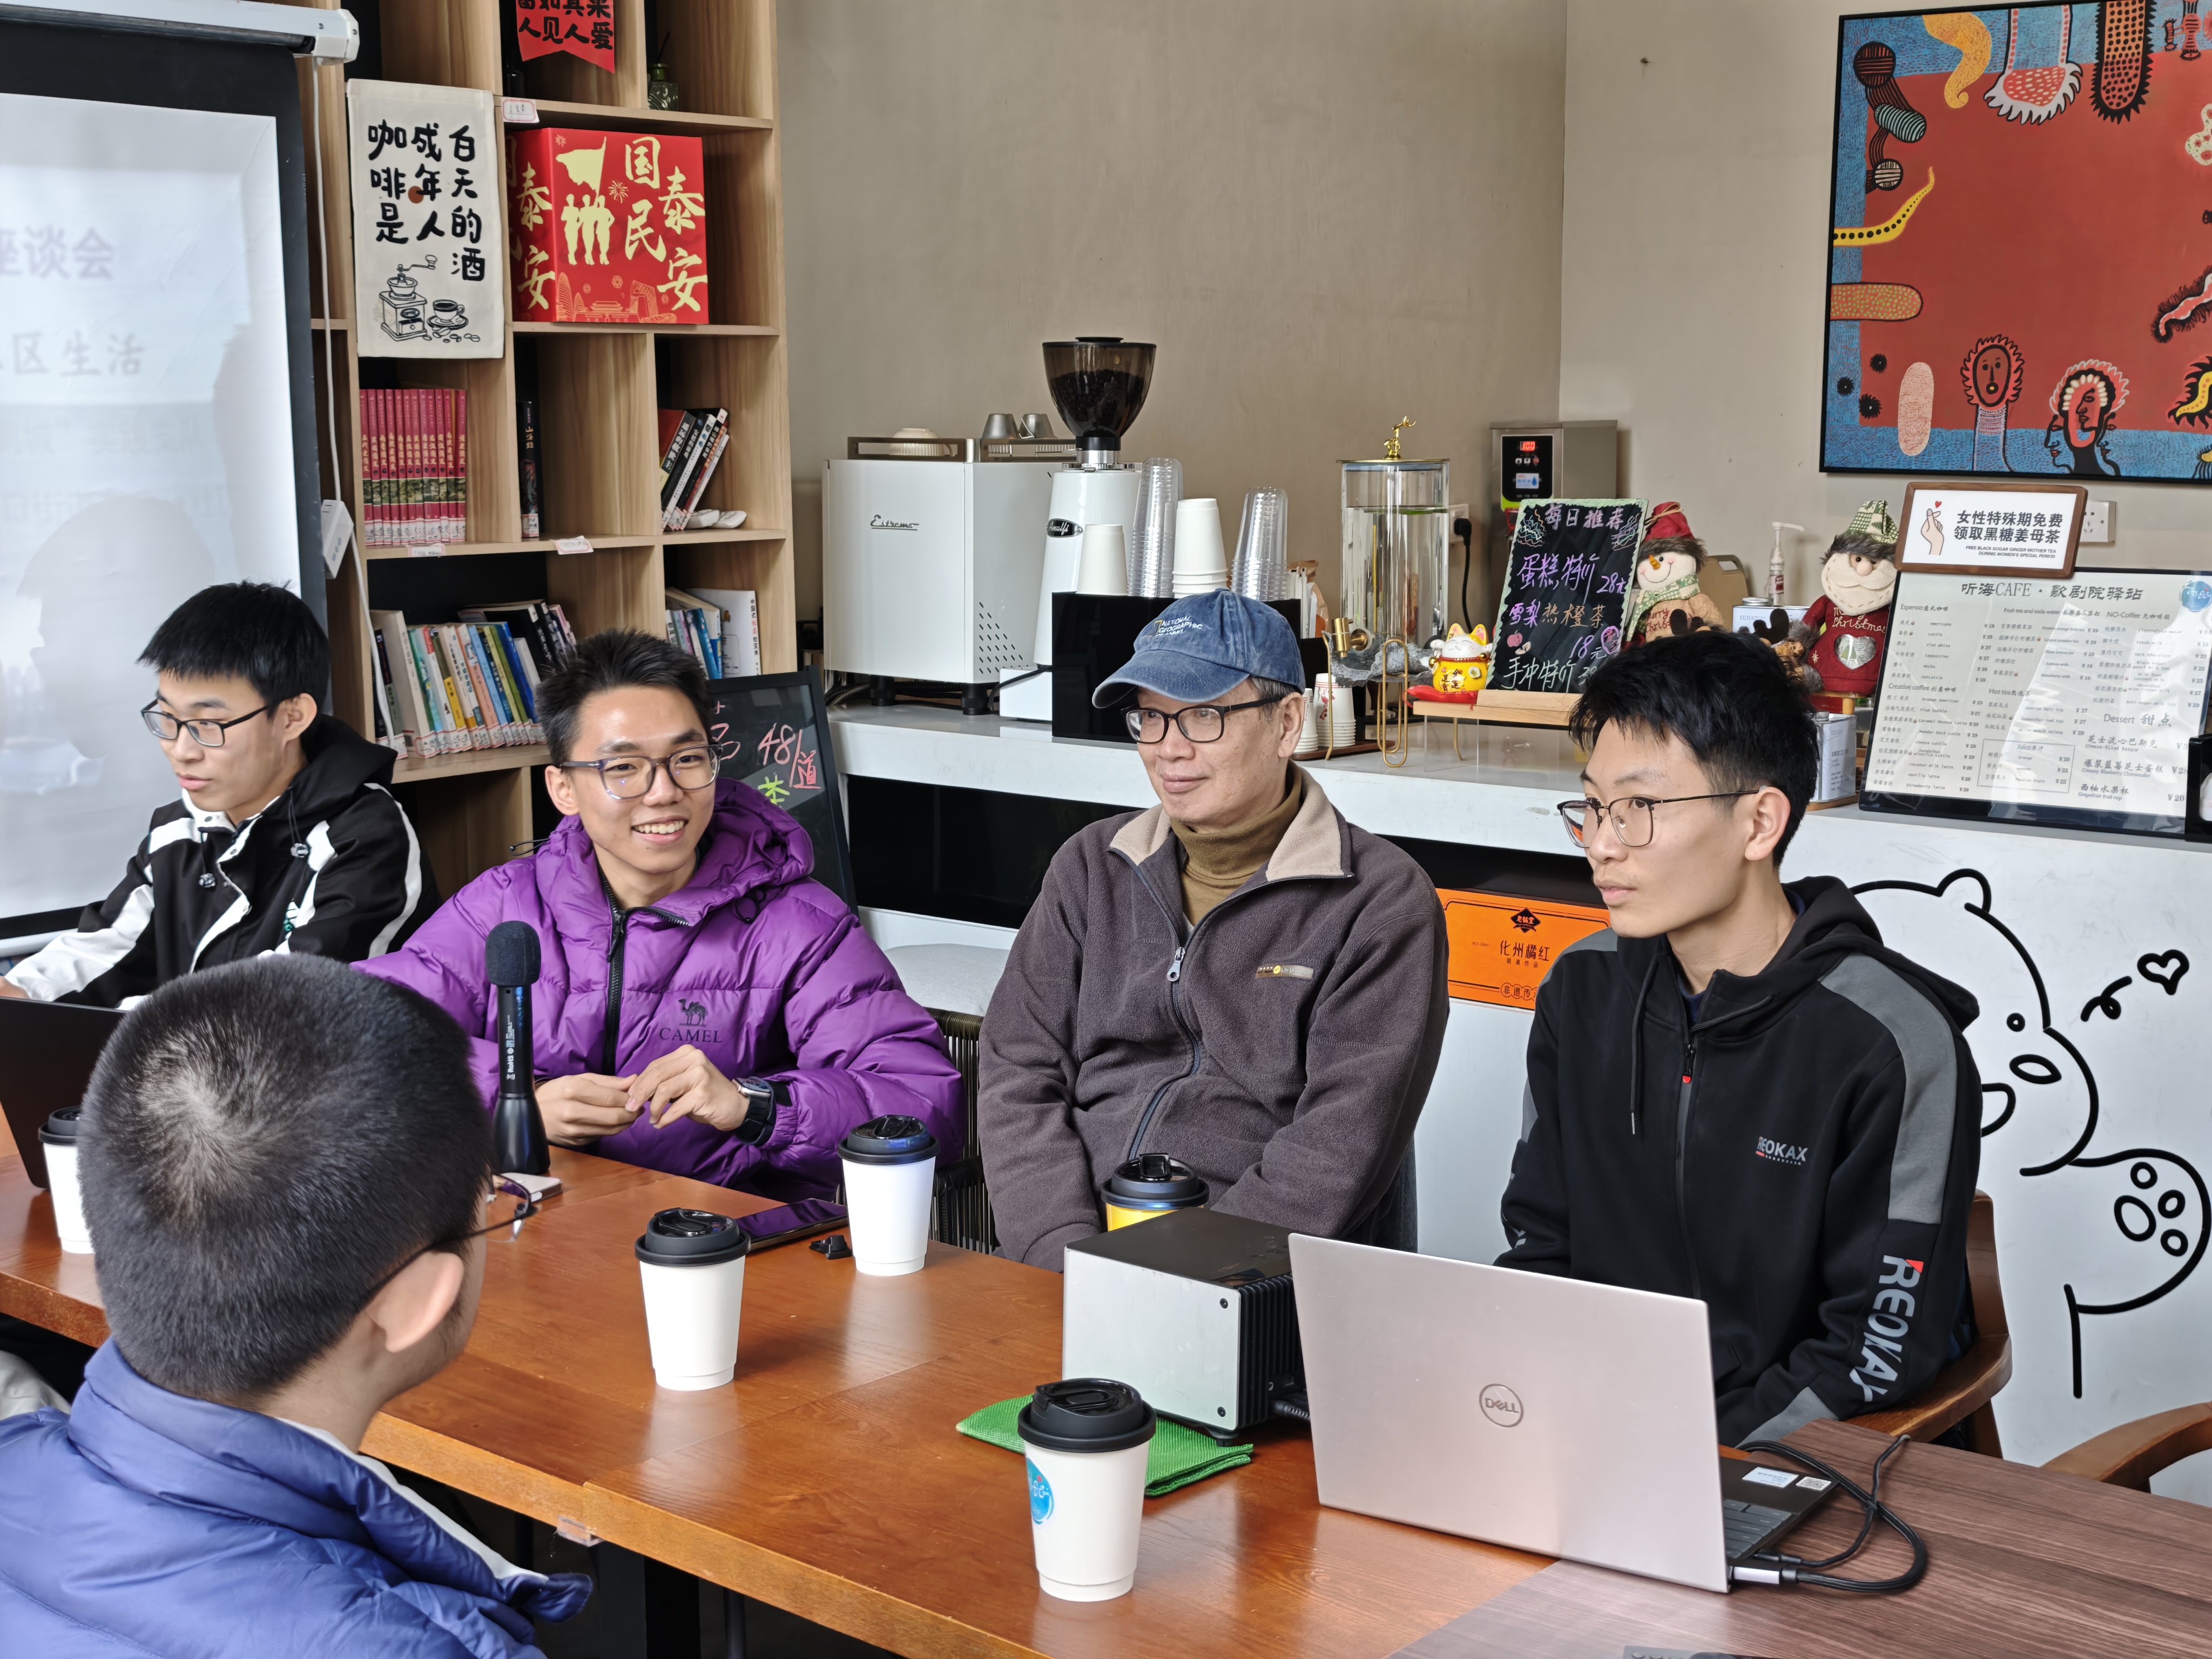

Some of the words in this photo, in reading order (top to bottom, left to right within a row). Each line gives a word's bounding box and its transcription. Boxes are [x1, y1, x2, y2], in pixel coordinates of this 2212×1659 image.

[518, 16, 613, 50] 人见人爱
[367, 119, 409, 245] 咖啡是
[411, 123, 445, 241] 成年人
[449, 124, 485, 282] 白天的酒
[0, 331, 145, 377] 区生活
[1545, 503, 1624, 530] 每日推荐
[1957, 510, 2063, 528] 女性特殊期免费
[1049, 521, 1070, 536] Amalfi
[1954, 525, 2060, 544] 领取黑糖姜母茶
[1516, 553, 1600, 605] 蛋糕特价
[1596, 572, 1626, 594] 28元
[1161, 615, 1191, 626] NATIONAL
[2104, 714, 2135, 724] Dessert
[2140, 713, 2171, 727] 甜点
[2088, 734, 2157, 748] 芝士流心巴斯克
[2083, 759, 2163, 773] 爆浆蓝莓芝士蛋糕
[2081, 784, 2129, 795] 西柚水果杯
[1500, 940, 1550, 961] 化州橘红
[1503, 985, 1537, 999] 非遗传
[659, 1027, 723, 1043] CAMEL
[1485, 1398, 1519, 1414] DELL
